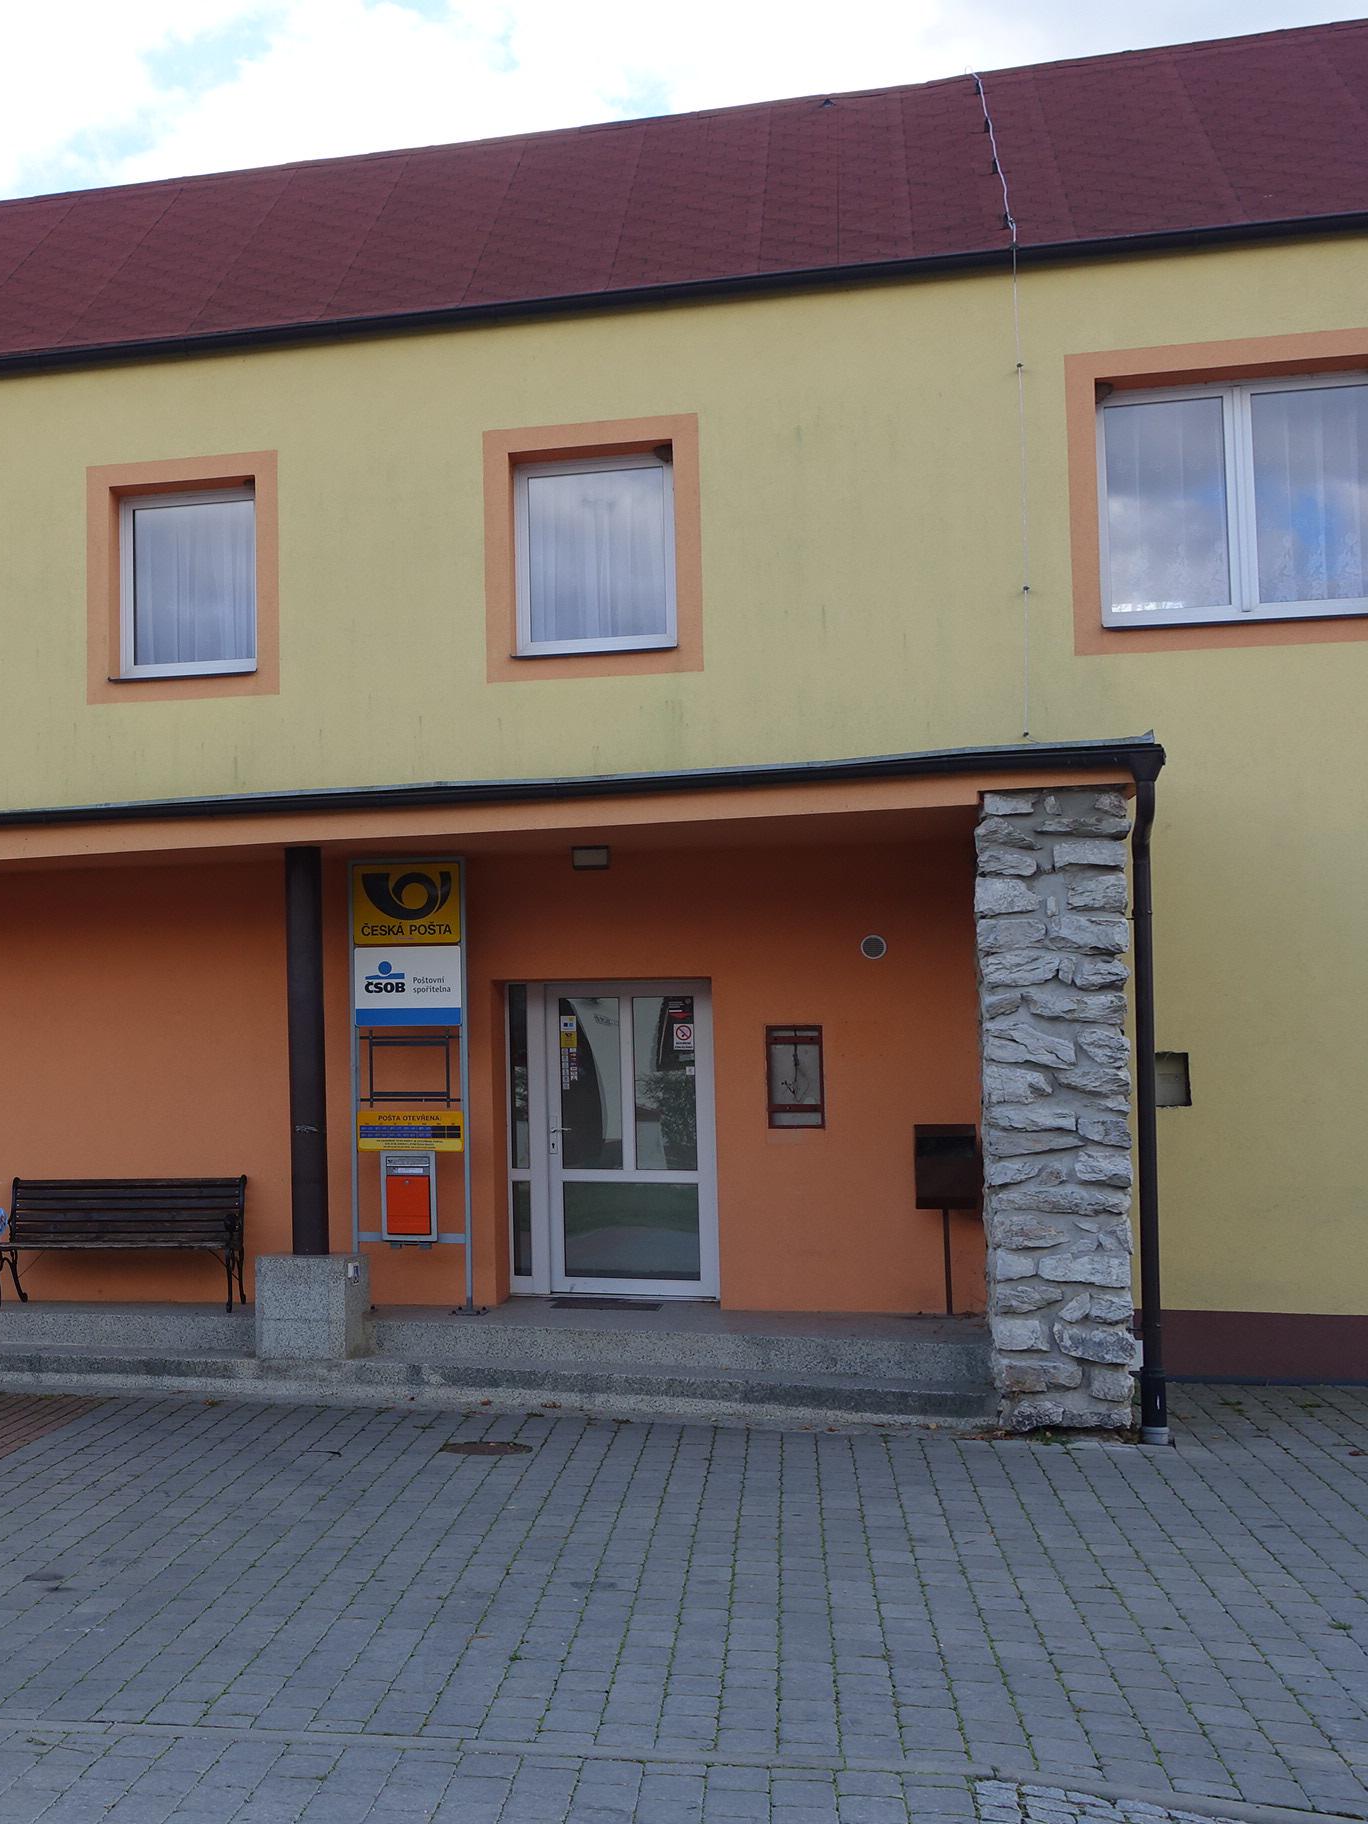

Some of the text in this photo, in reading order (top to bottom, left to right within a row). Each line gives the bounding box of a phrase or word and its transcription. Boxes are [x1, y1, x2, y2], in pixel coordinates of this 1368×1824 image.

[361, 921, 452, 936] ČESKÁ POŠTA
[364, 980, 406, 994] ČSOB
[412, 976, 445, 985] Poštovní
